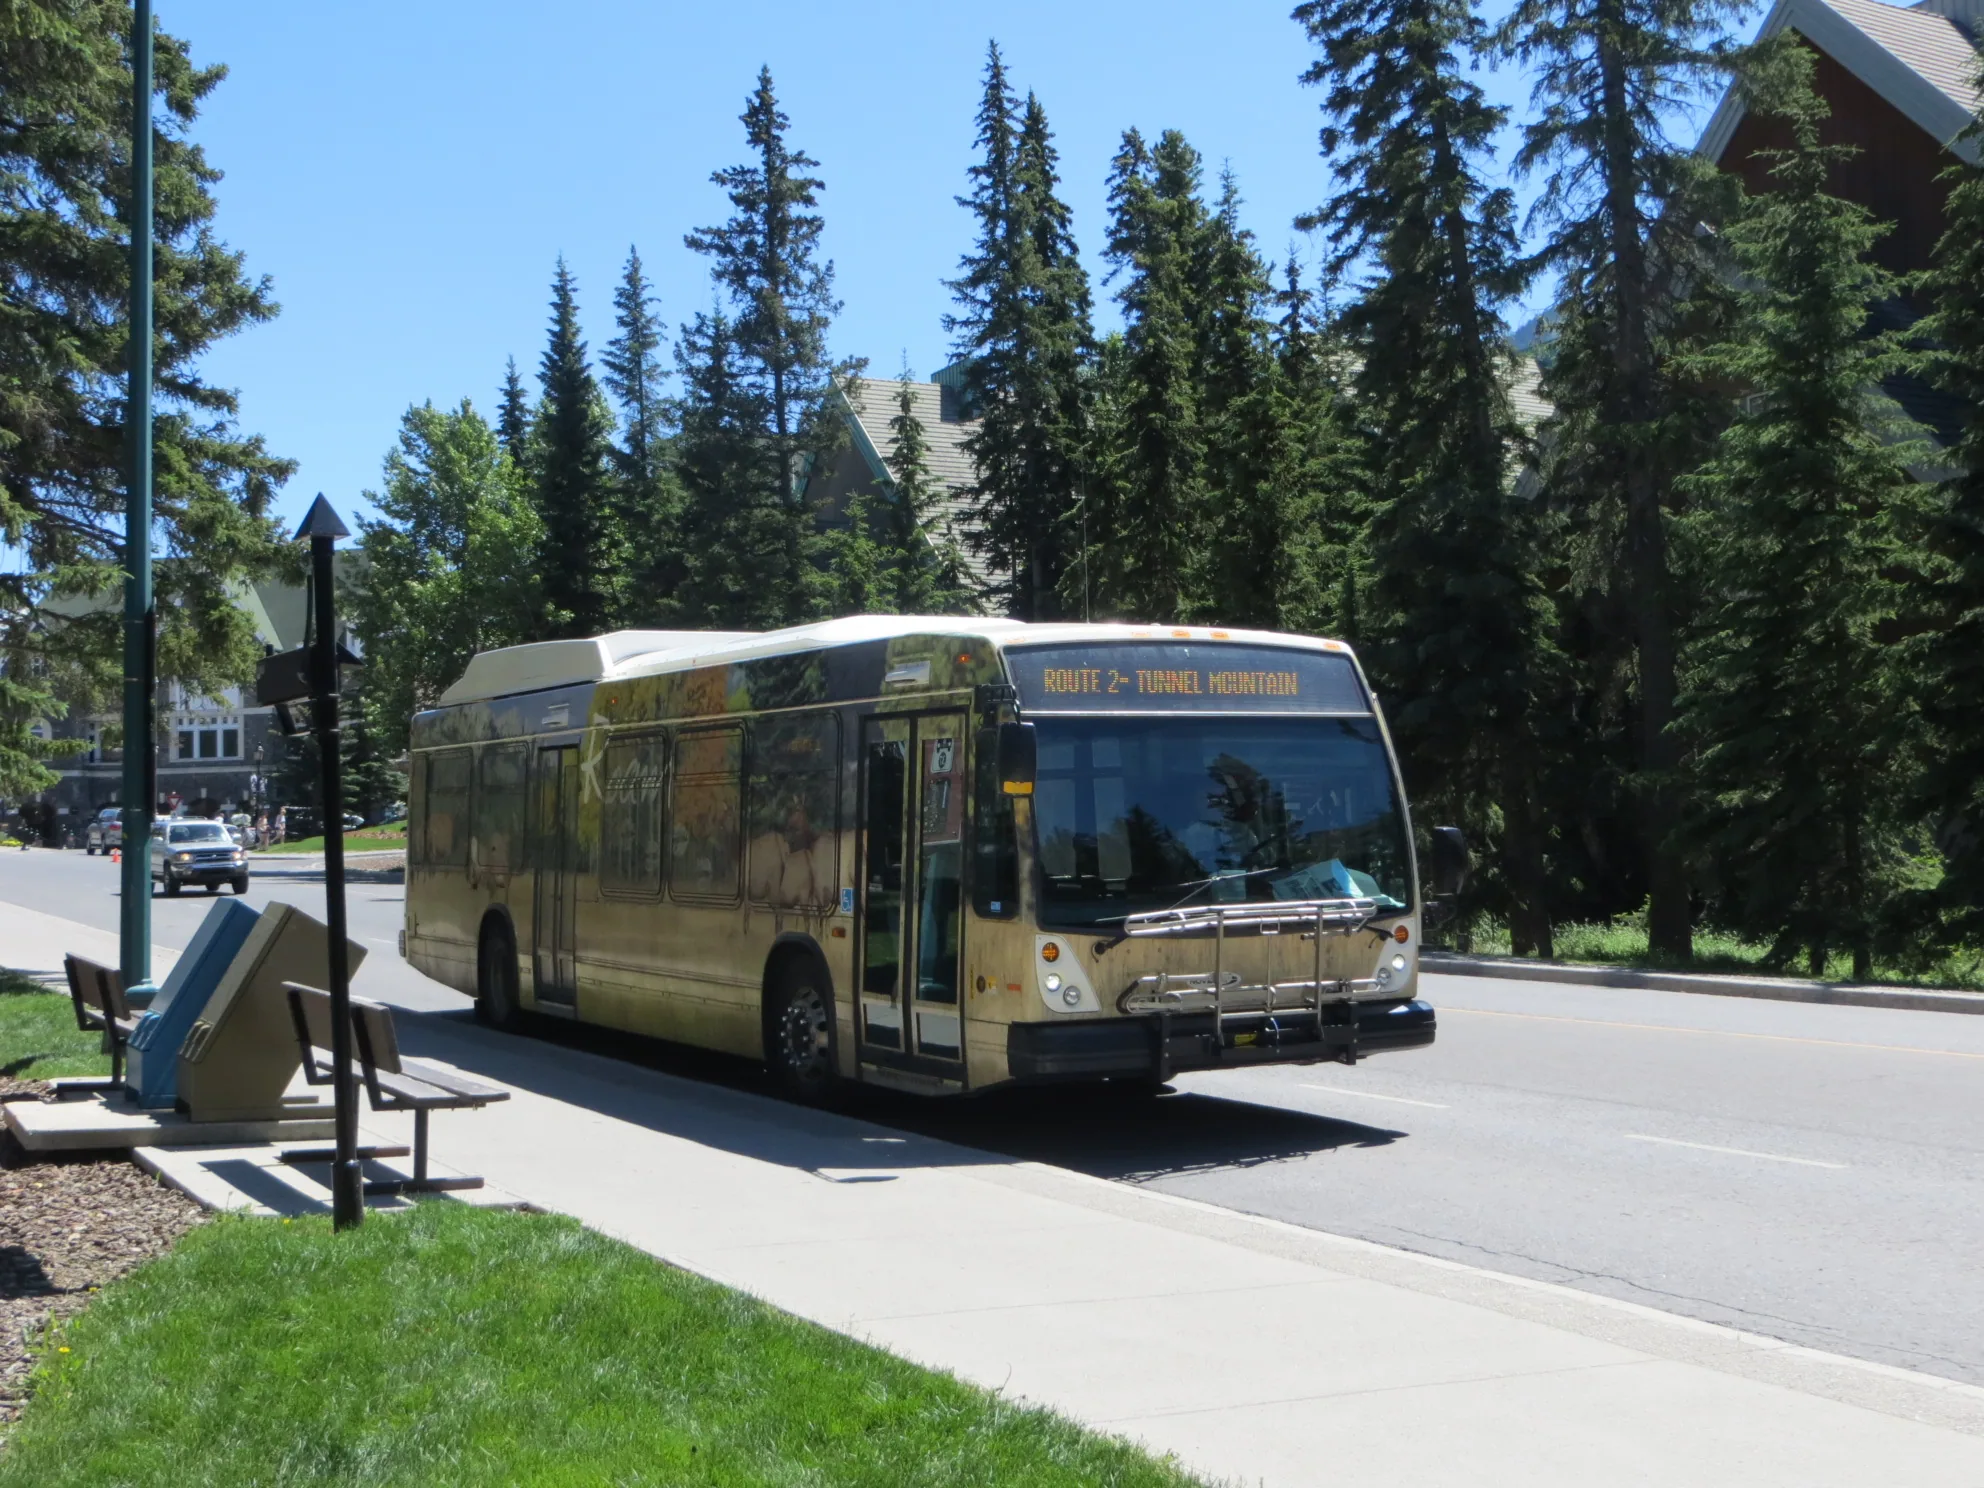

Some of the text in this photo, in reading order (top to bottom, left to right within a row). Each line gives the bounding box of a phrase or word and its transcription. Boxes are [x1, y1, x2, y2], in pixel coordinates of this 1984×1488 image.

[1044, 669, 1101, 693] ROUTE
[1136, 670, 1203, 694] TUNNEL
[1208, 671, 1298, 695] MOUNTAIN
